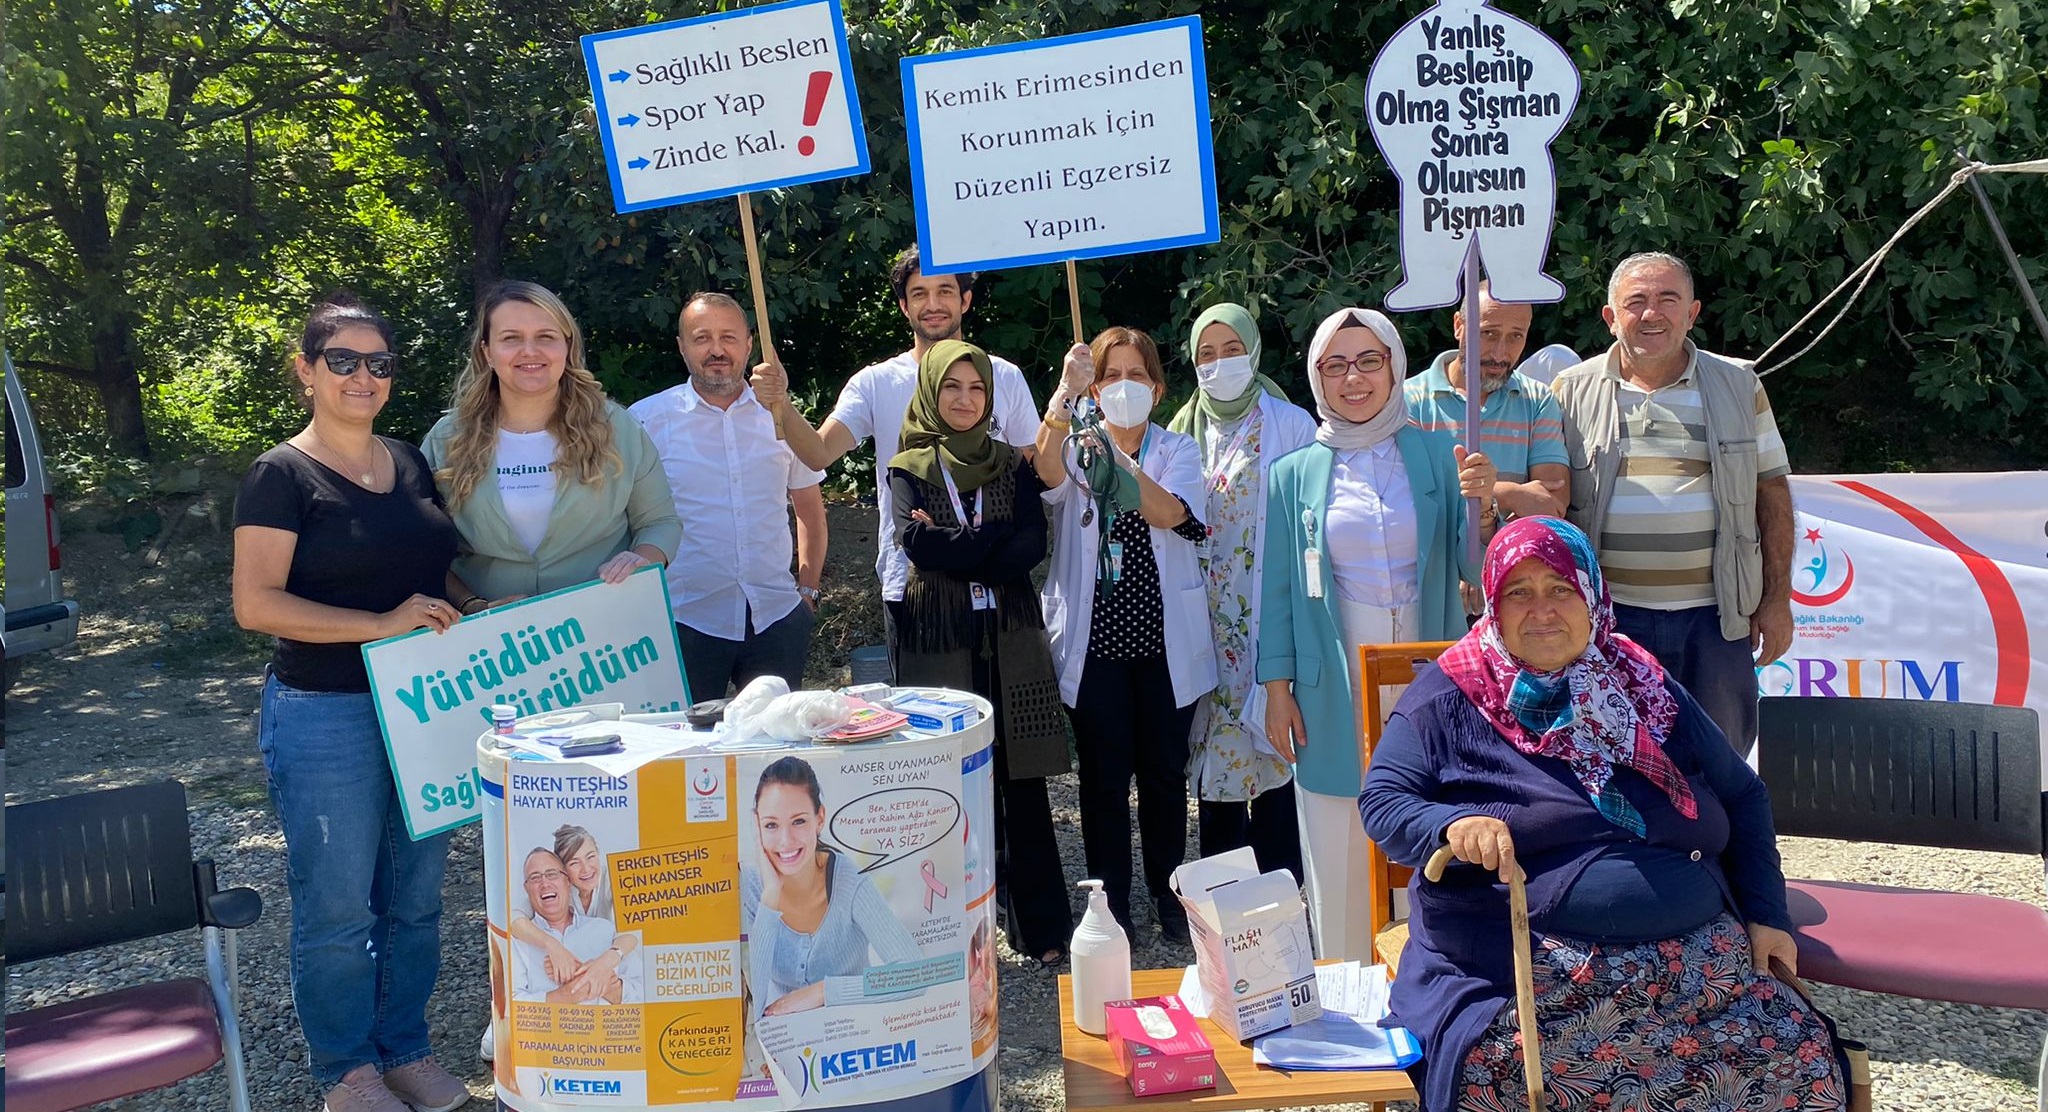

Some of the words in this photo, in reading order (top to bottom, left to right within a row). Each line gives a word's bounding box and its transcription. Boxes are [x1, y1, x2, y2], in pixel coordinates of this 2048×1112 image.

[1420, 14, 1506, 56] Yanlış
[635, 50, 732, 86] Sağlıklı
[739, 36, 829, 68] Beslen
[1416, 50, 1533, 91] Beslenip
[924, 81, 1008, 110] Kemik
[1016, 59, 1184, 98] Erimesinden
[644, 102, 707, 131] Spor
[714, 92, 765, 116] Yap
[1375, 89, 1450, 126] Olma
[1458, 86, 1561, 130] Şişman
[961, 117, 1097, 153] Korunmak
[1105, 109, 1155, 138] İçin
[1430, 124, 1509, 158] Sonra
[653, 140, 728, 171] Zinde
[735, 130, 785, 156] Kal.
[954, 169, 1052, 201] Düzenli
[1062, 155, 1172, 191] Egzersiz
[1417, 159, 1526, 196] Olursun
[1023, 215, 1106, 240] Yapın.
[1422, 197, 1525, 240] Pişman
[496, 464, 552, 478] agina
[1794, 614, 1816, 625] ağlık
[1818, 614, 1865, 625] Bakanlığı
[395, 616, 585, 724] Yürüdüm
[1755, 658, 1965, 702] ORUM
[840, 761, 885, 775] KANSER
[888, 753, 953, 771] UYANMADAN
[512, 774, 563, 792] ERKEN
[872, 774, 894, 786] SEN
[897, 771, 930, 783] UYAN!
[512, 794, 552, 809] HAYAT
[556, 795, 628, 810] KURTARIR
[889, 799, 929, 811] KETEM'de
[859, 825, 897, 836] taraması
[877, 838, 895, 850] YA
[616, 854, 661, 872] ERKEN
[662, 845, 709, 866] TEŞHİS
[619, 873, 647, 892] İÇİN
[649, 866, 703, 885] KANSER
[620, 879, 732, 907] TARAMALARINIZI
[623, 904, 688, 925] YAPTIRIN!
[655, 949, 731, 966] HAYATINIZ
[656, 964, 697, 981] BİZİM
[701, 962, 732, 981] İÇİN
[1290, 983, 1311, 1008] 50
[602, 1008, 625, 1017] 50-70
[625, 1008, 641, 1017] YAŞ
[1238, 1001, 1266, 1013] KORUYUCU
[1239, 1007, 1268, 1019] PROTECTIVE
[1268, 1002, 1283, 1010] MASK
[668, 1025, 730, 1037] farkındayız
[668, 1034, 731, 1048] KANSERİ
[518, 1040, 575, 1053] TARAMALAR
[576, 1043, 597, 1055] İÇİN
[552, 1056, 606, 1068] BAŞVURUN
[820, 1039, 917, 1080] KETEM
[1137, 1060, 1158, 1069] tenty
[554, 1077, 621, 1093] KETEM
